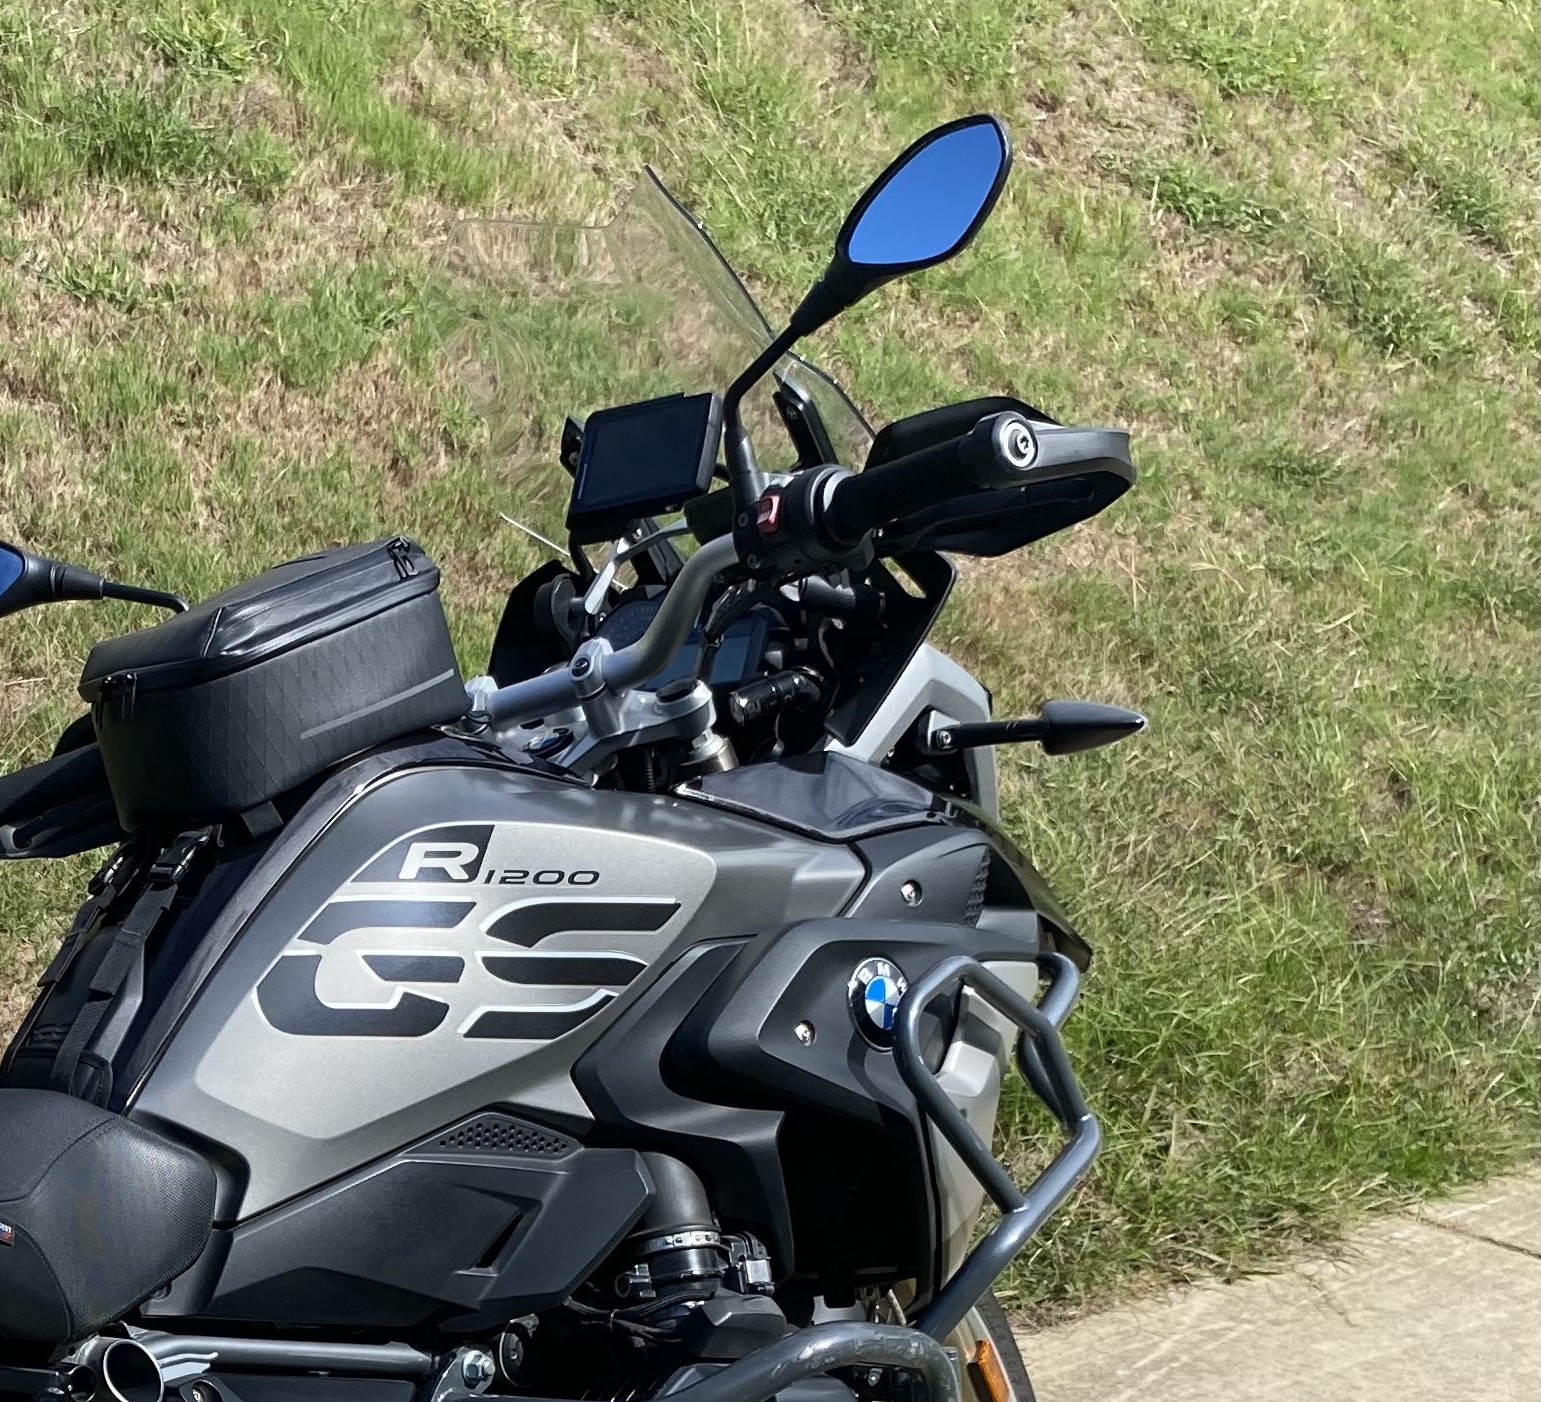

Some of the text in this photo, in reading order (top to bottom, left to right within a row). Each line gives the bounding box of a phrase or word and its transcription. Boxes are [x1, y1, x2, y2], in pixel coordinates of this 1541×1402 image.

[398, 841, 601, 886] R 1200
[254, 894, 682, 1040] GS
[857, 962, 908, 993] BMW
